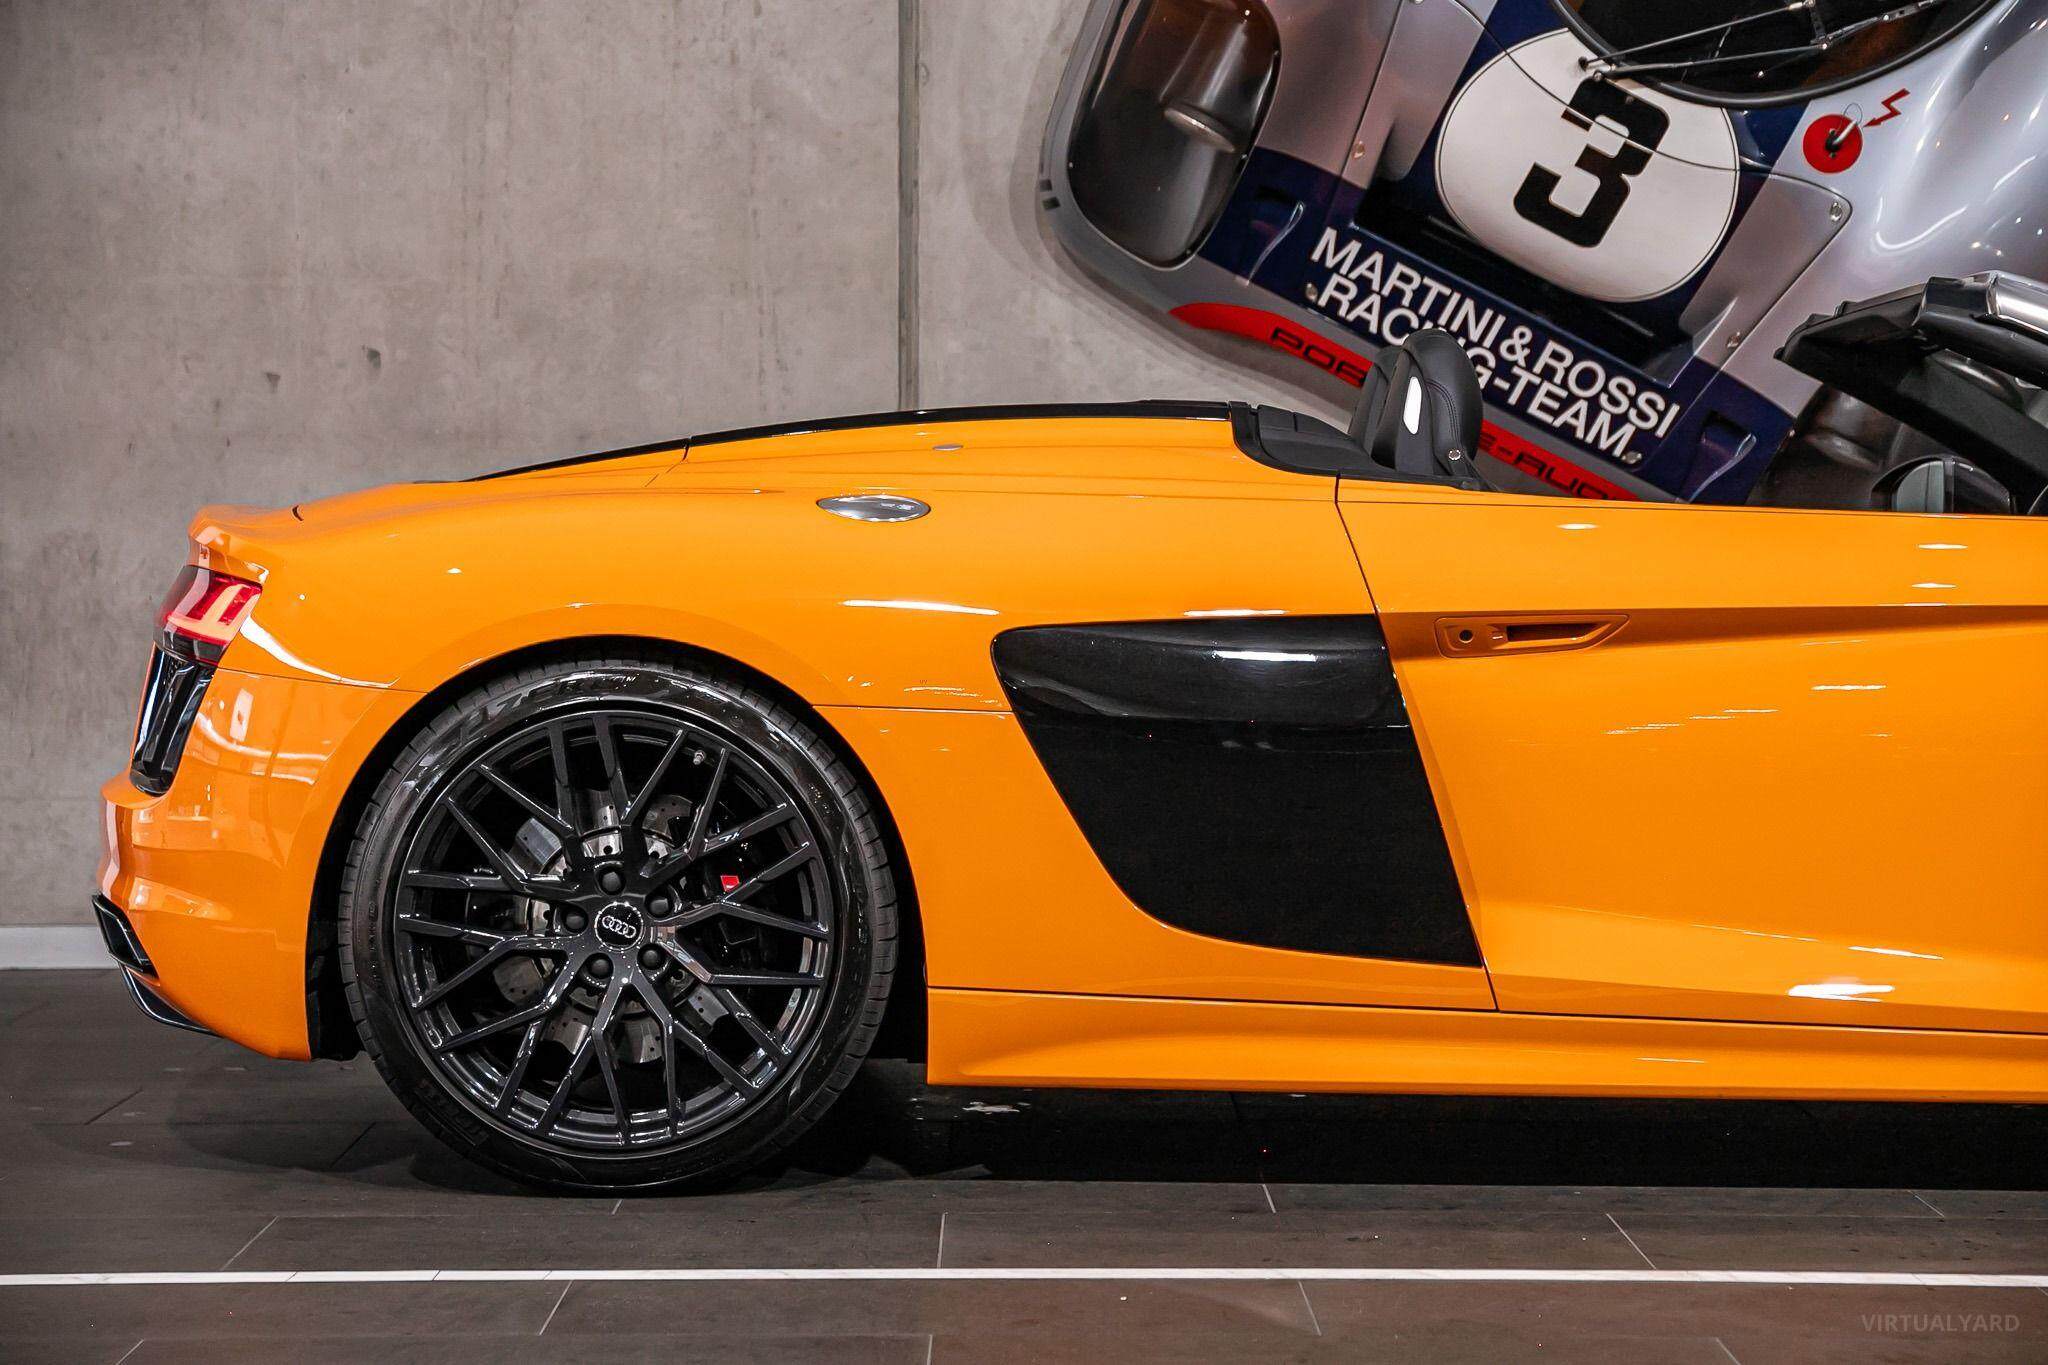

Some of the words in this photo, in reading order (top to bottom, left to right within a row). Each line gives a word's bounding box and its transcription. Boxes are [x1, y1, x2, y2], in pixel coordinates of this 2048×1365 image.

[1513, 75, 1670, 248] 3
[1310, 226, 1507, 349] MARTINI
[1500, 325, 1533, 368] &
[1533, 340, 1681, 438] ROSSI
[1317, 272, 1636, 458] RACG-TEAM
